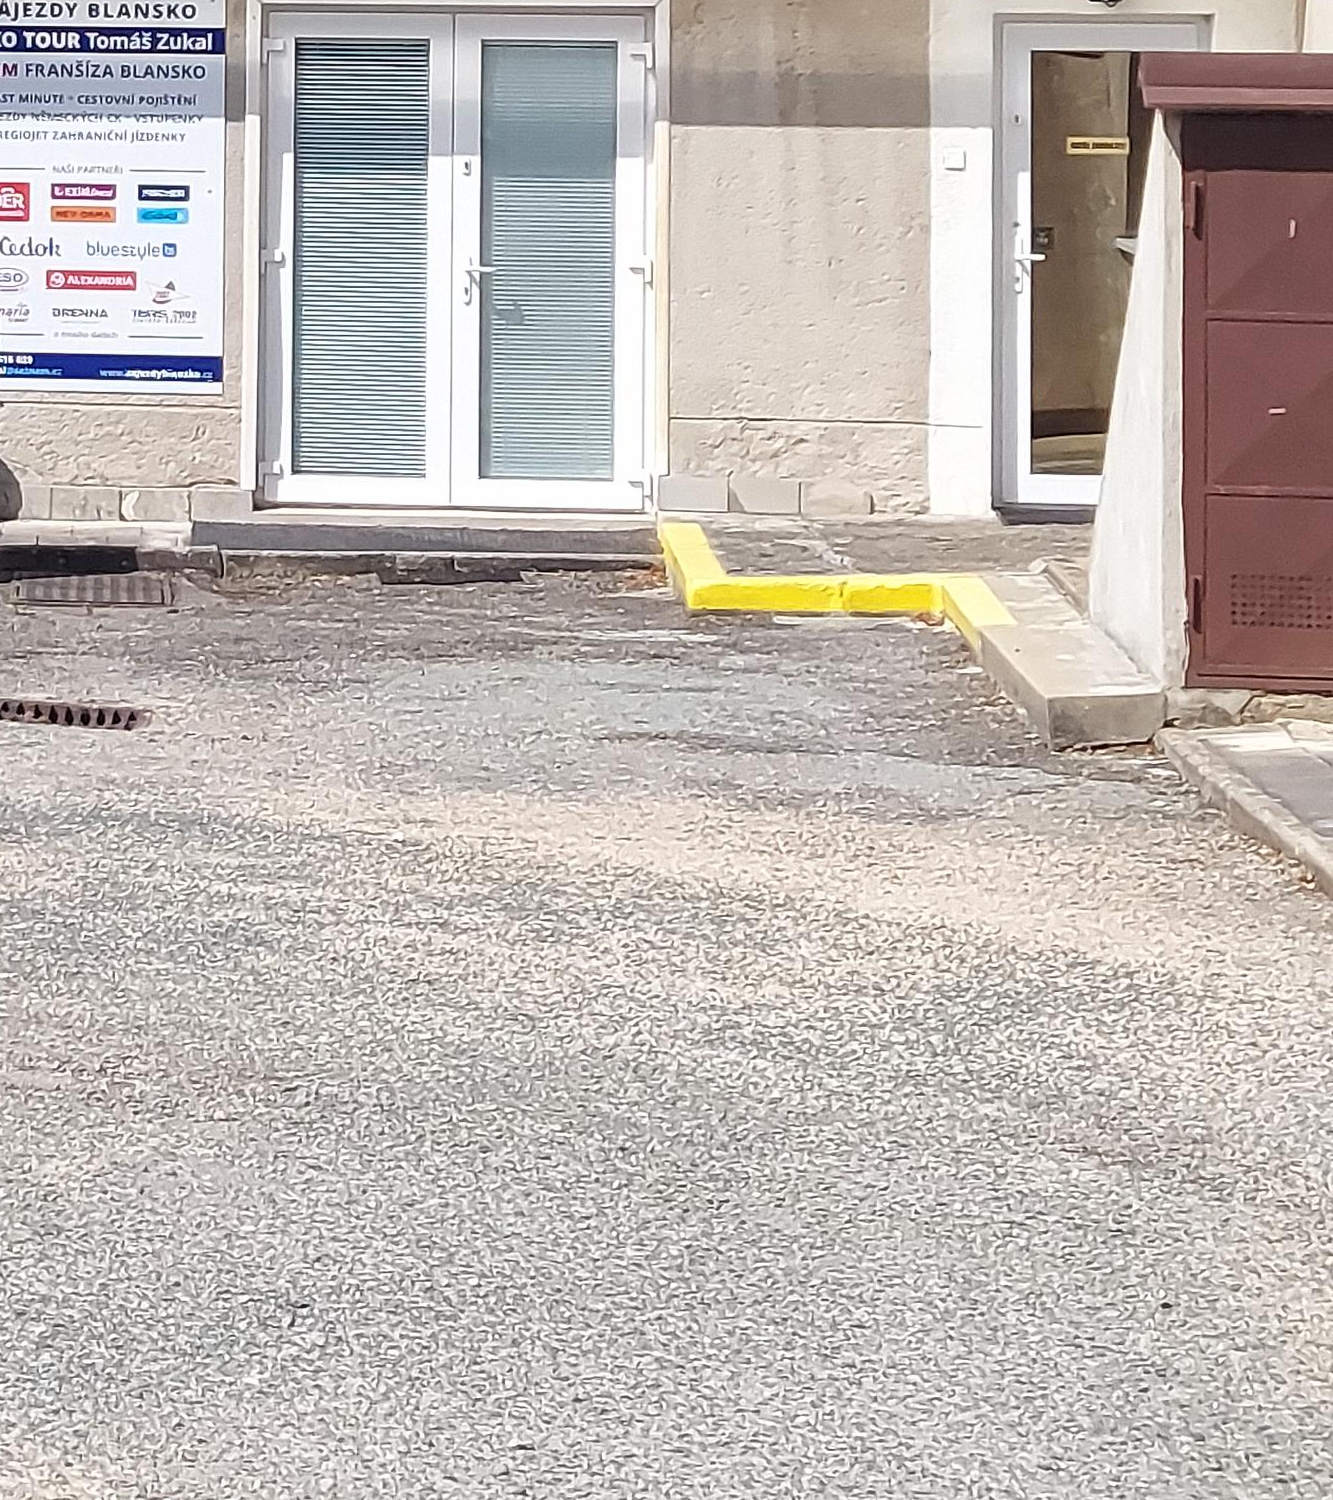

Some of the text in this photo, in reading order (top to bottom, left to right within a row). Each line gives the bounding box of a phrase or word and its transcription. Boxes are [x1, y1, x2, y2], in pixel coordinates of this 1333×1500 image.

[88, 3, 197, 19] BLANSKO
[23, 32, 80, 49] TOUR
[85, 31, 152, 51] Tomáš
[156, 32, 213, 51] Zukal
[25, 60, 114, 79] FRANŠÍZA
[120, 64, 206, 79] BLANSKO
[18, 94, 64, 104] MINUTE
[77, 93, 134, 105] CESTOVNÍ
[139, 94, 196, 107] POJIŠTĚNÍ
[52, 129, 127, 141] ZAHRANIČNÍ
[131, 130, 186, 143] JÍZDENKY
[87, 240, 160, 261] bluestyle
